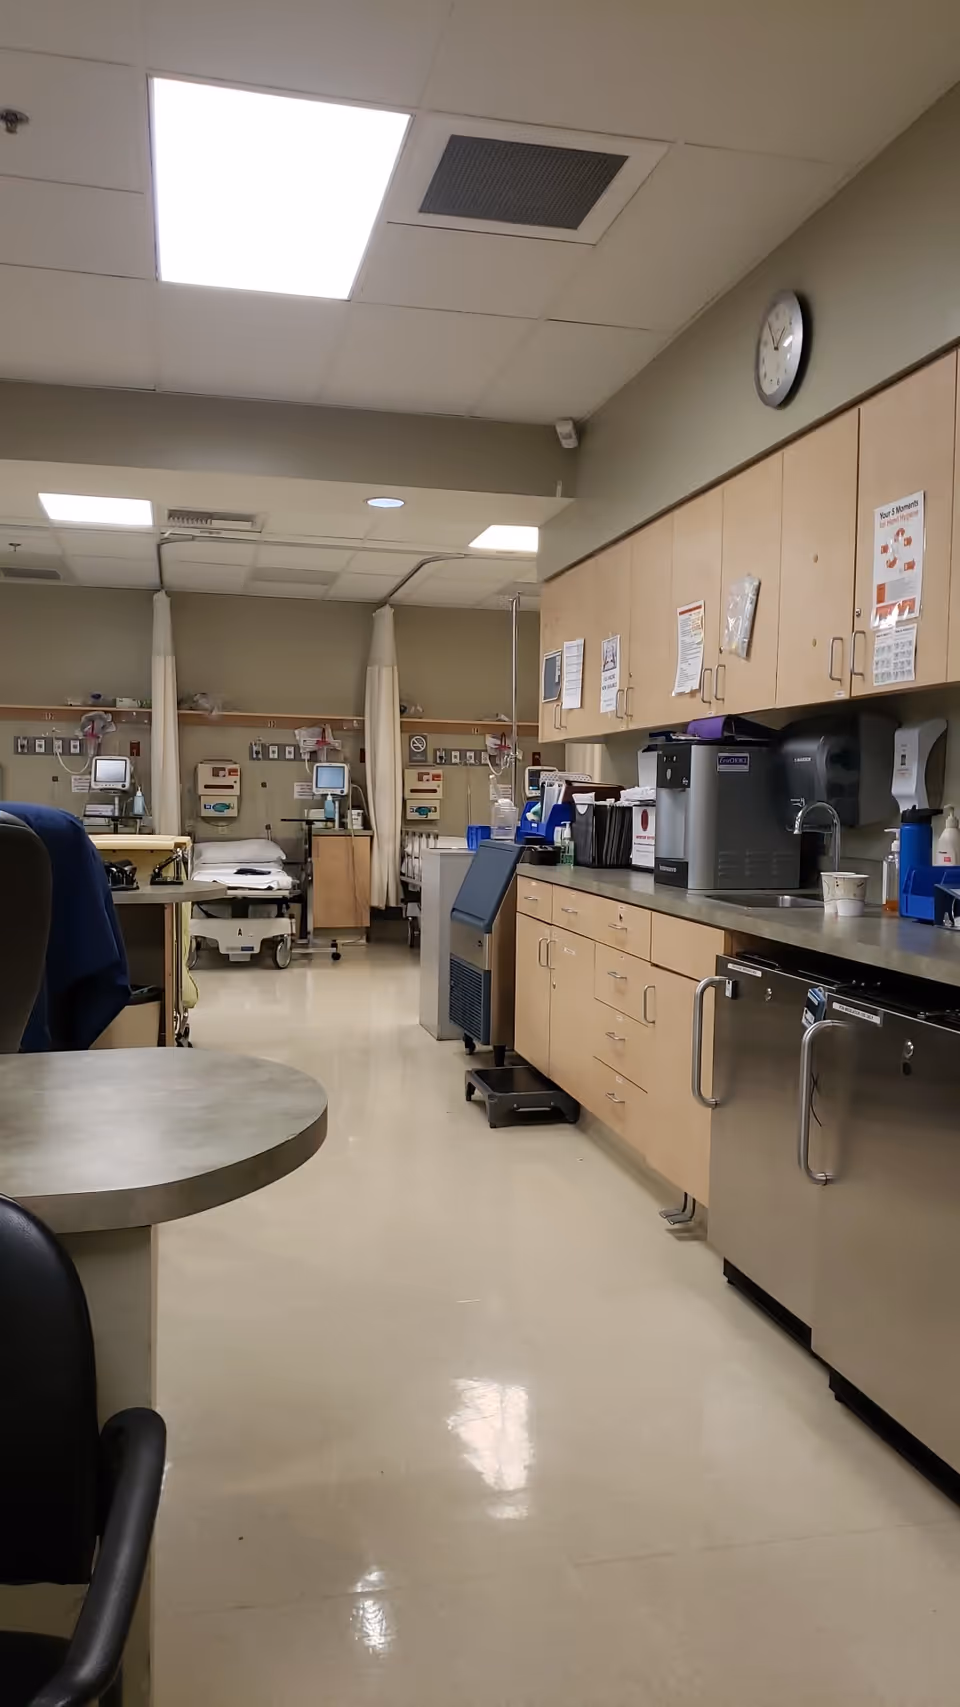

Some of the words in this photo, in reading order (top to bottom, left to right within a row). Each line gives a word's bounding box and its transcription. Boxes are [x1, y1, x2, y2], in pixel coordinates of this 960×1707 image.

[880, 510, 891, 520] Your
[896, 500, 919, 514] Moments
[237, 928, 243, 936] A
